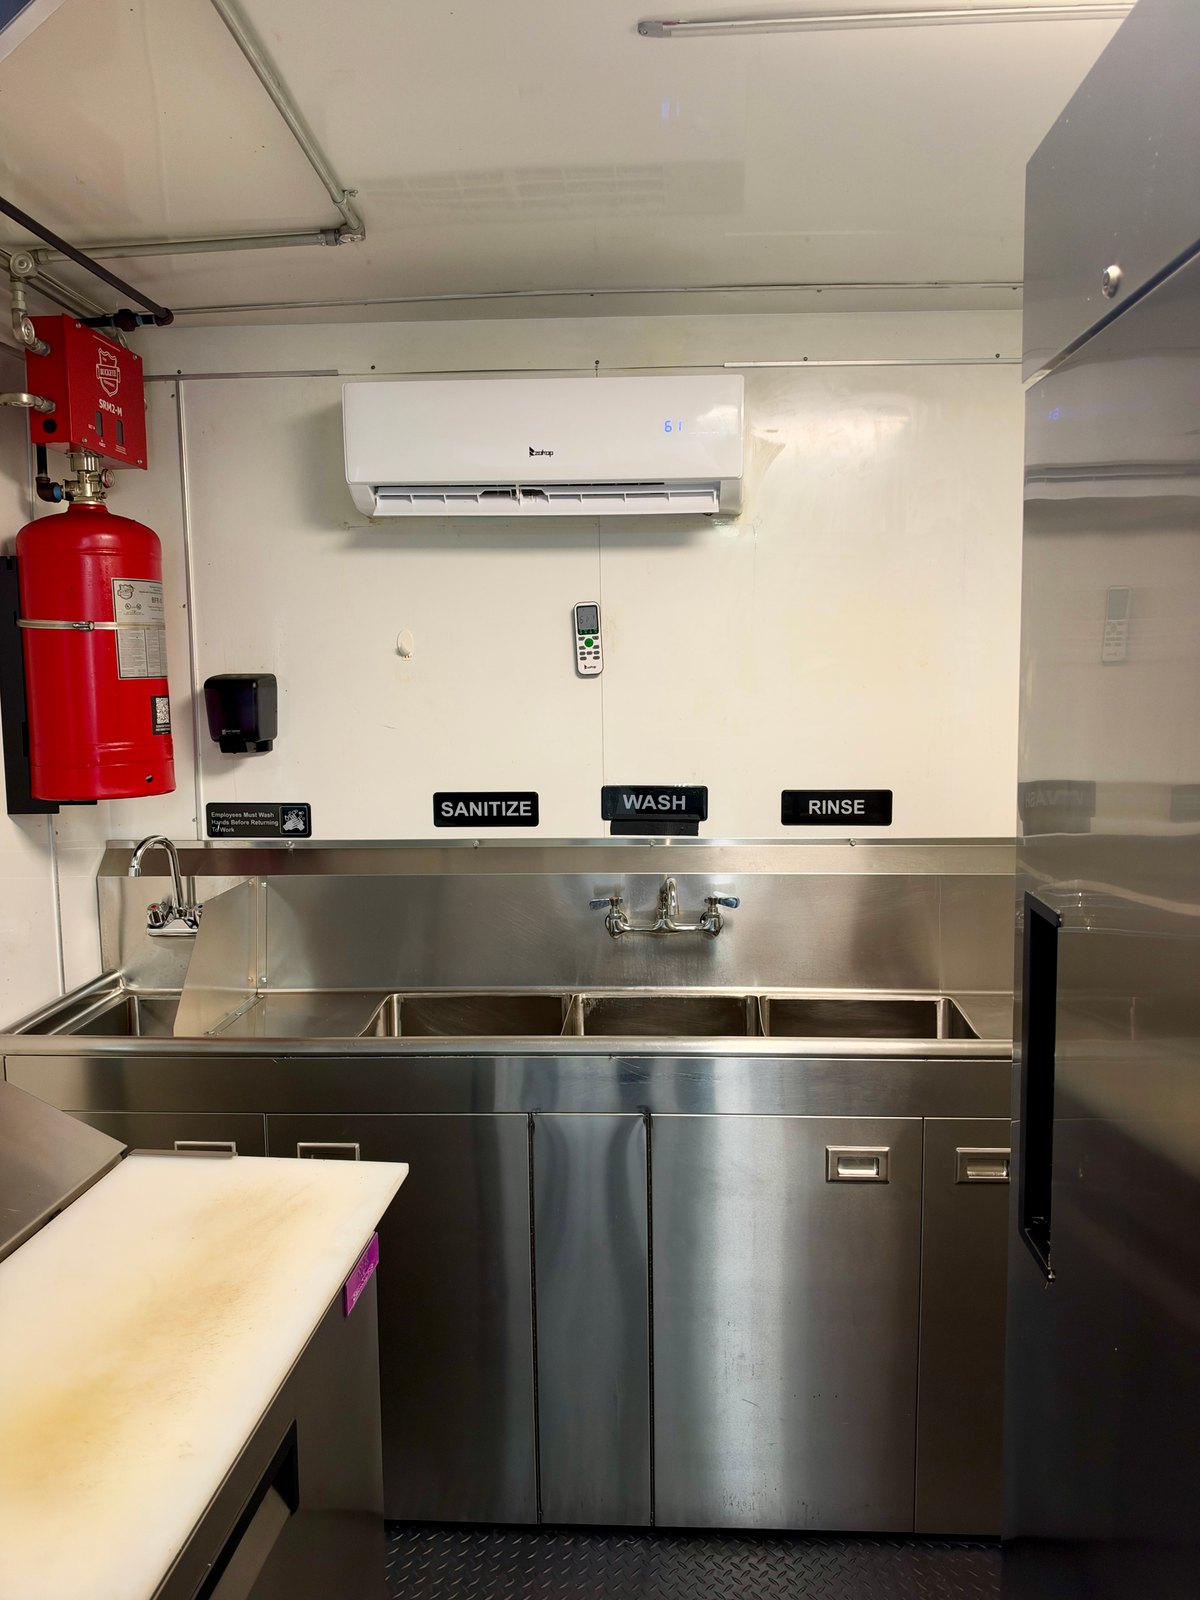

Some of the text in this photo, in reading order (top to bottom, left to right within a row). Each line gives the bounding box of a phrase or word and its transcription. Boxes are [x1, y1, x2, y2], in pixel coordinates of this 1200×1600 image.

[98, 398, 123, 416] SRM2-M
[664, 420, 682, 433] 61
[441, 801, 532, 817] SANITIZE
[622, 794, 686, 810] WASH
[808, 799, 865, 815] RINSE
[250, 819, 279, 827] Returning
